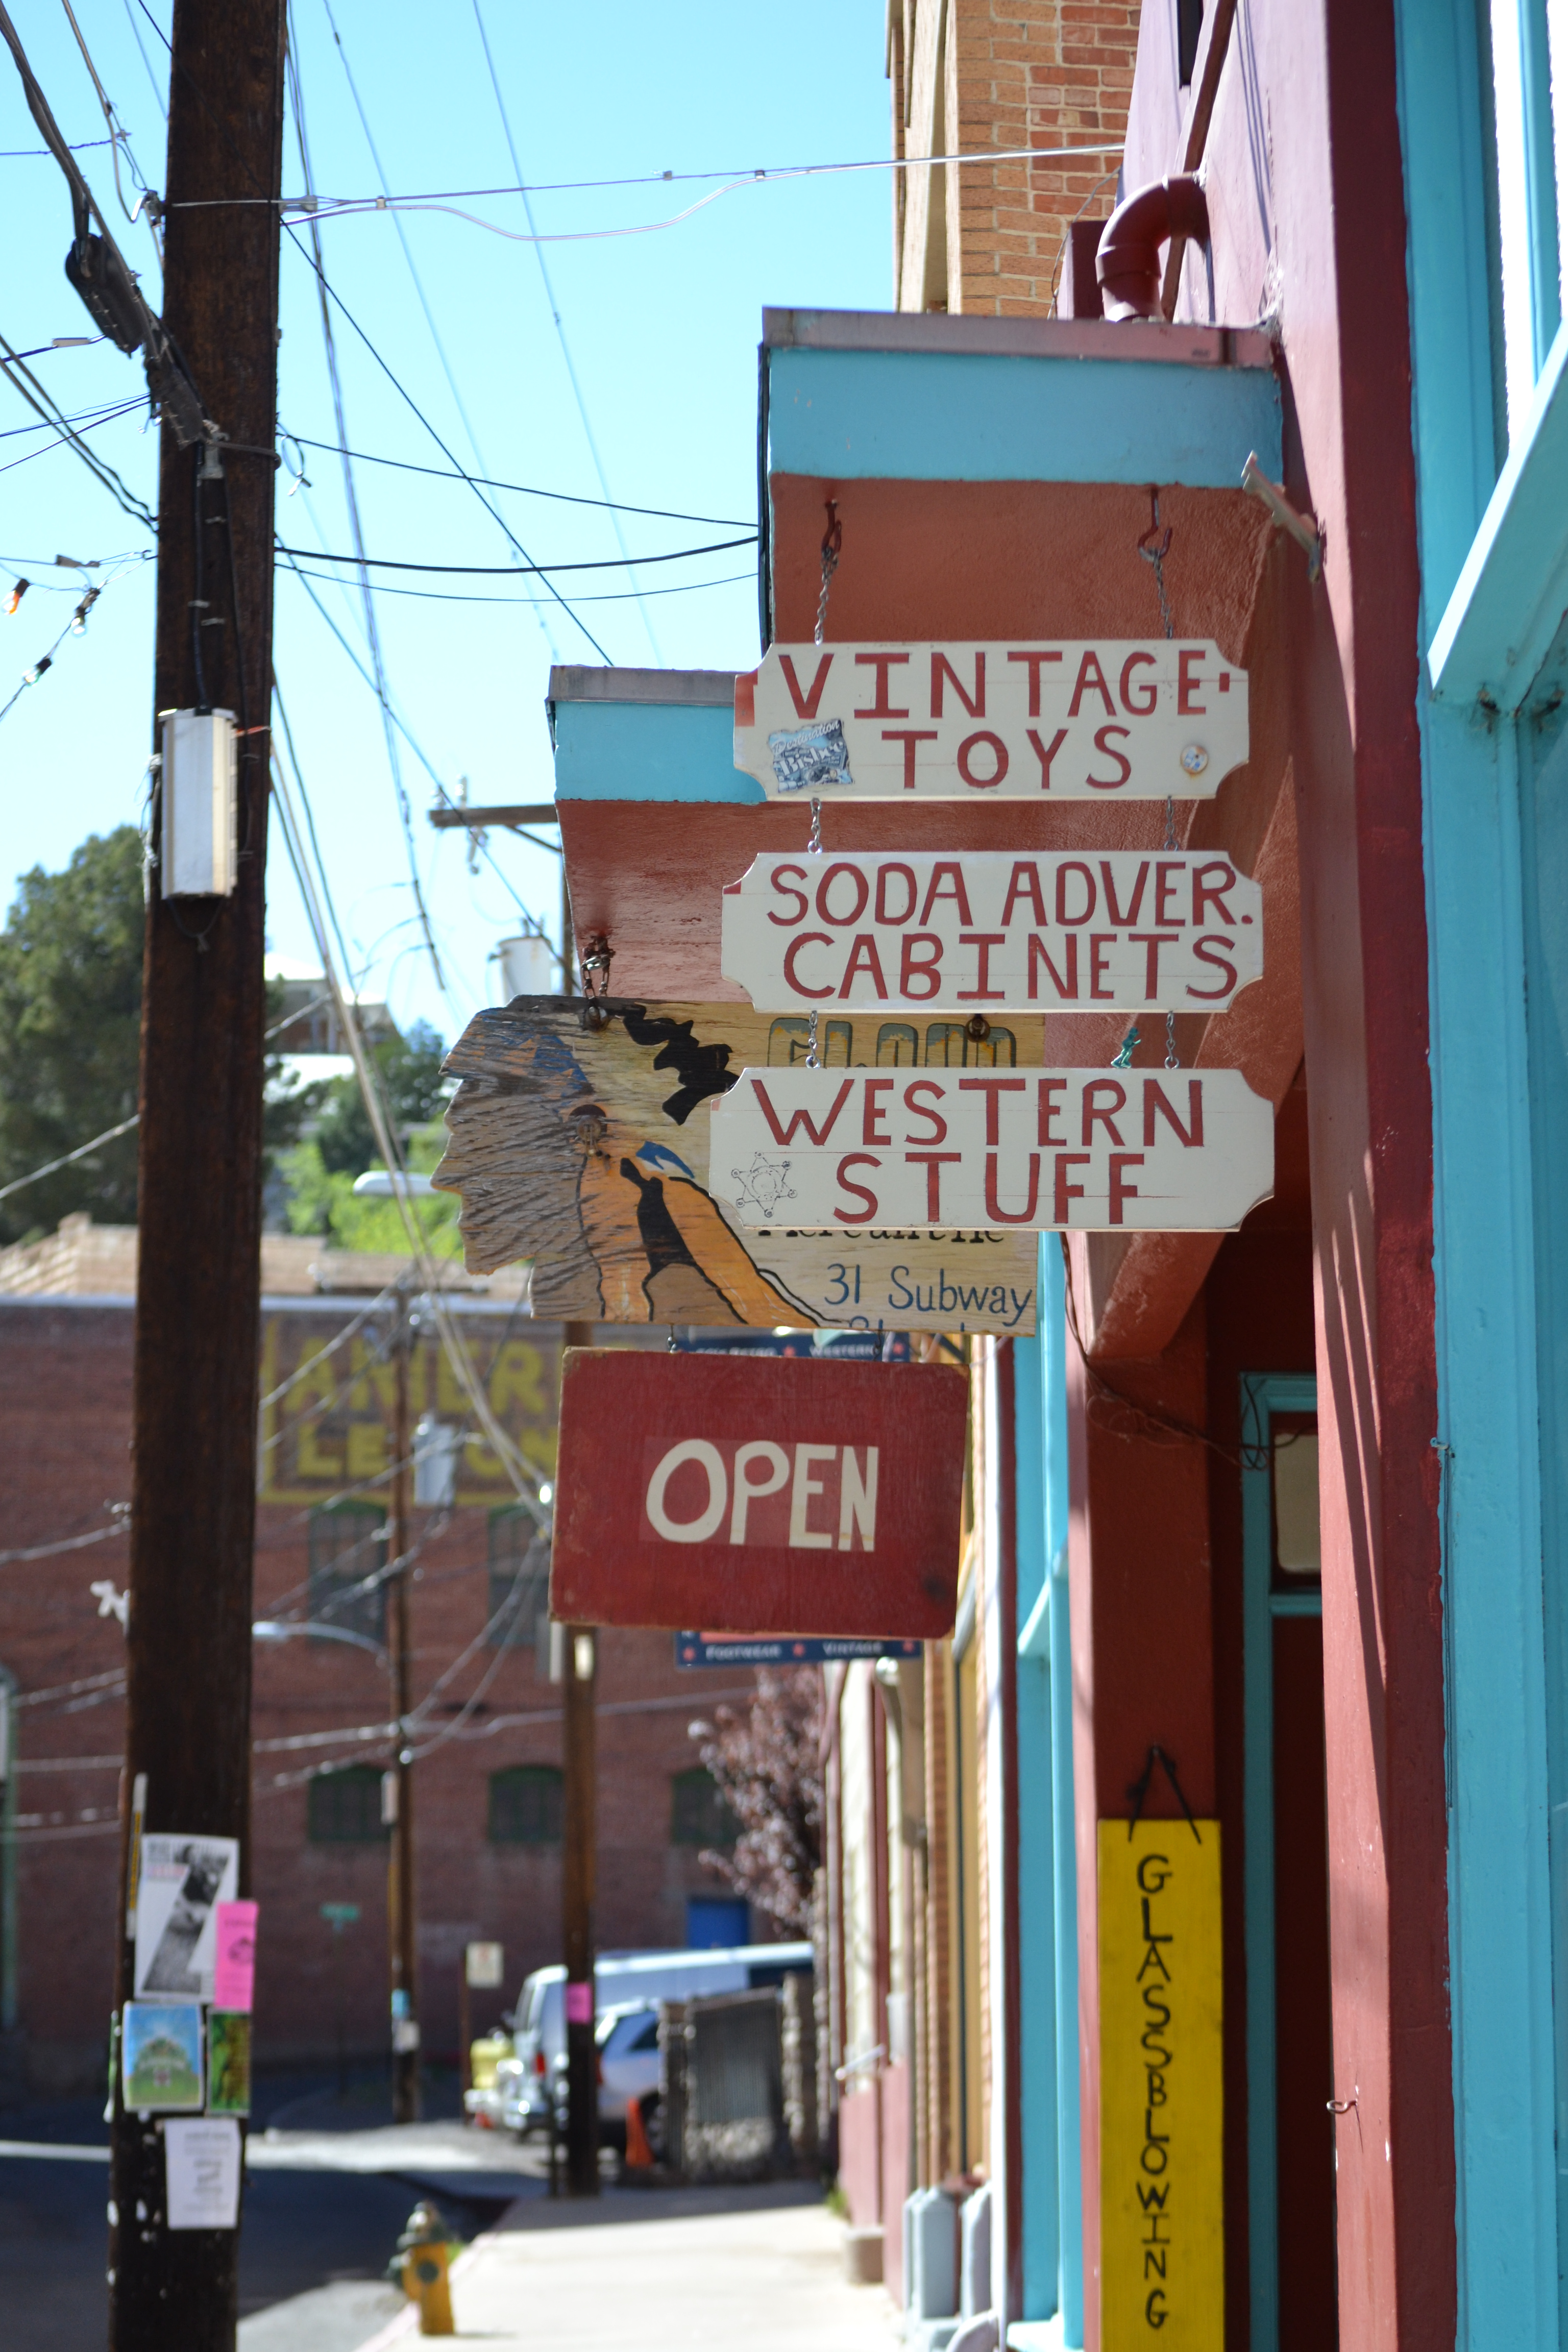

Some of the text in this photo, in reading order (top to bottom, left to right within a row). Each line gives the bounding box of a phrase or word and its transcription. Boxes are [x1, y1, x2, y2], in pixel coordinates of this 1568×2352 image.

[778, 650, 1207, 720] VINTAGE
[772, 720, 840, 756] Destination
[779, 741, 844, 776] Bisbee
[881, 725, 1132, 790] TOYS
[767, 861, 1254, 927] SODA ADVER.
[783, 932, 1238, 1001] CABINETS
[750, 1078, 1205, 1147] WESTERN
[833, 1152, 1145, 1225] STUFF
[824, 1263, 1033, 1327] 31 Subway
[810, 1343, 879, 1360] WESTERN
[645, 1438, 879, 1552] OPEN
[705, 1640, 883, 1660] FOOTWEAR VINTAGE
